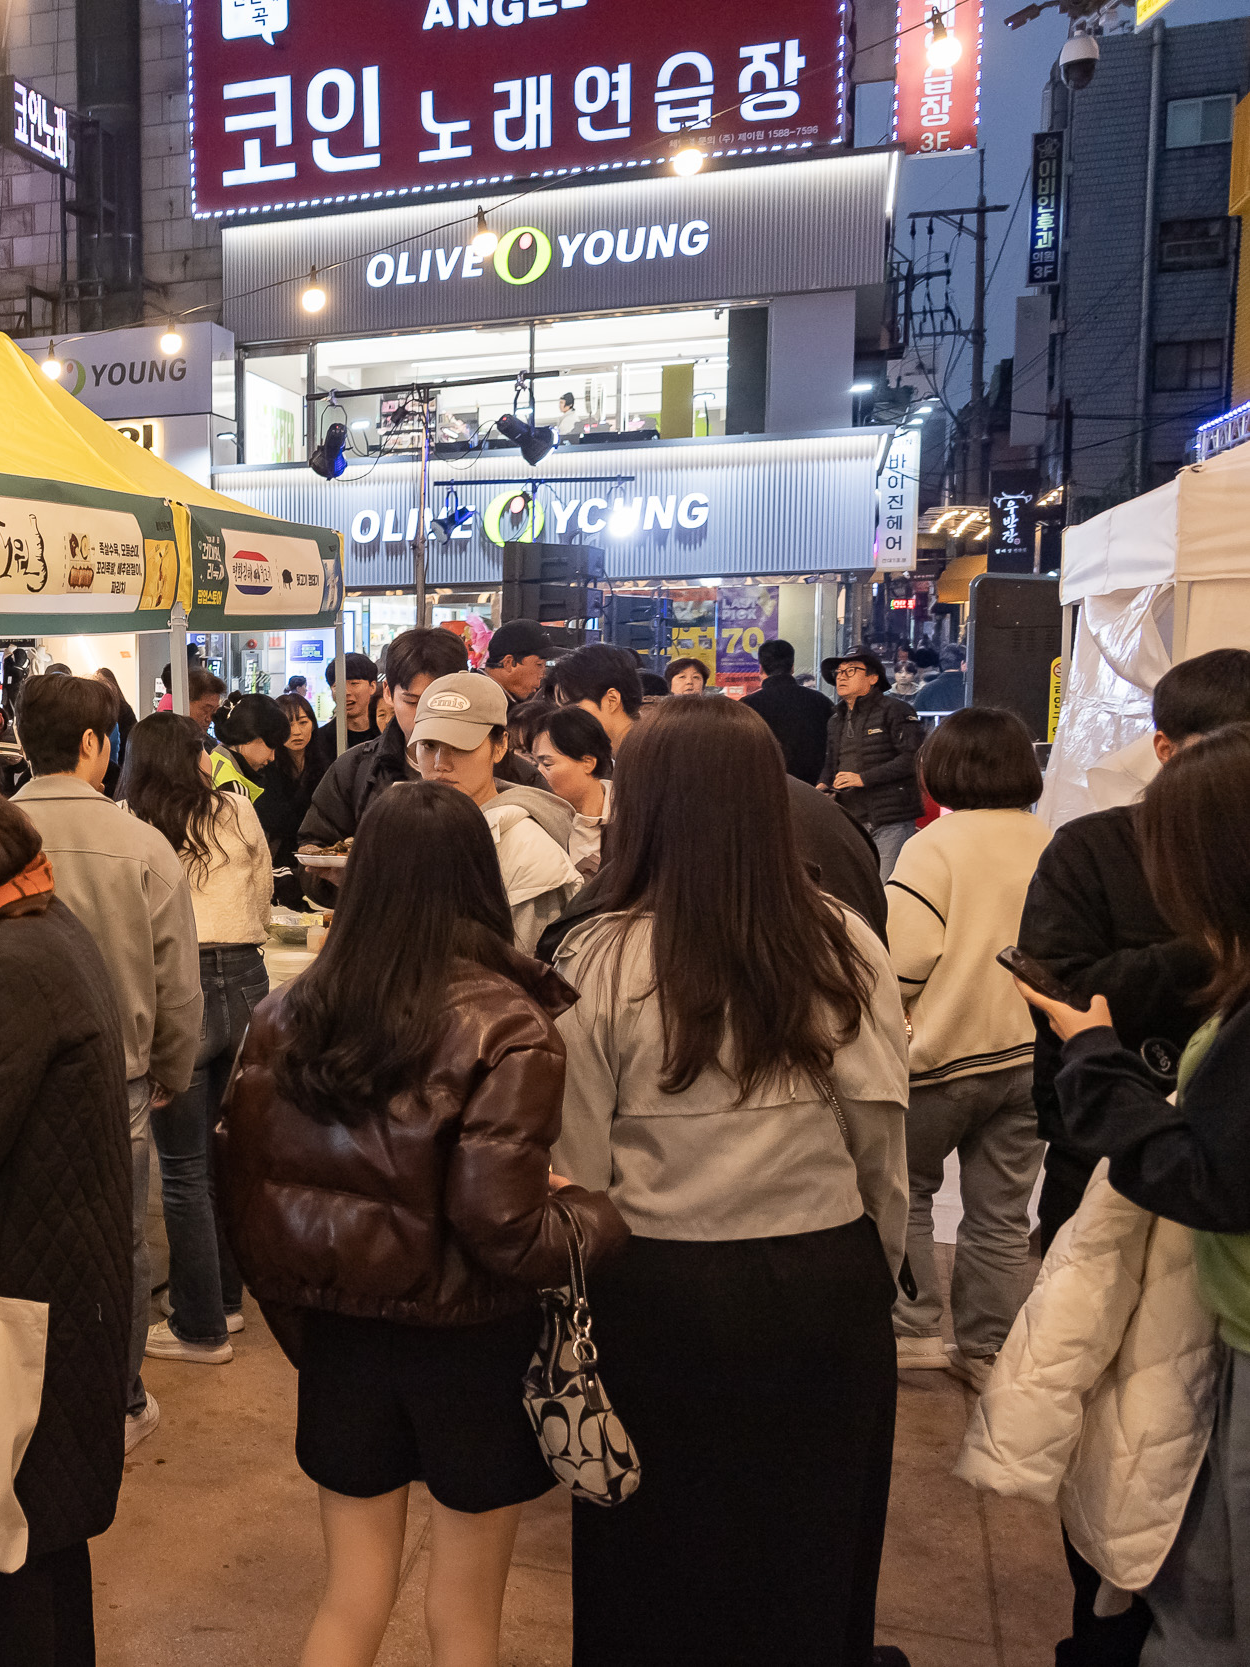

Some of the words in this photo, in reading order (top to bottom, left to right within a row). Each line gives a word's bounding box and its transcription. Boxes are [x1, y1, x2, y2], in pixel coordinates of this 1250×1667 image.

[423, 0, 588, 29] ANGE
[14, 81, 68, 169] 코인노래
[222, 65, 382, 187] 코인
[419, 39, 806, 164] 노래연습장
[718, 133, 735, 144] (주)
[767, 125, 819, 139] 1588-7596
[920, 130, 951, 152] 3F
[366, 245, 485, 288] OLIVE
[557, 219, 710, 269] YOUNG
[1033, 264, 1054, 279] 3F
[91, 357, 187, 388] YOUNG
[884, 452, 907, 551] 바이진헤어
[721, 626, 765, 655] 70
[430, 697, 466, 710] emis
